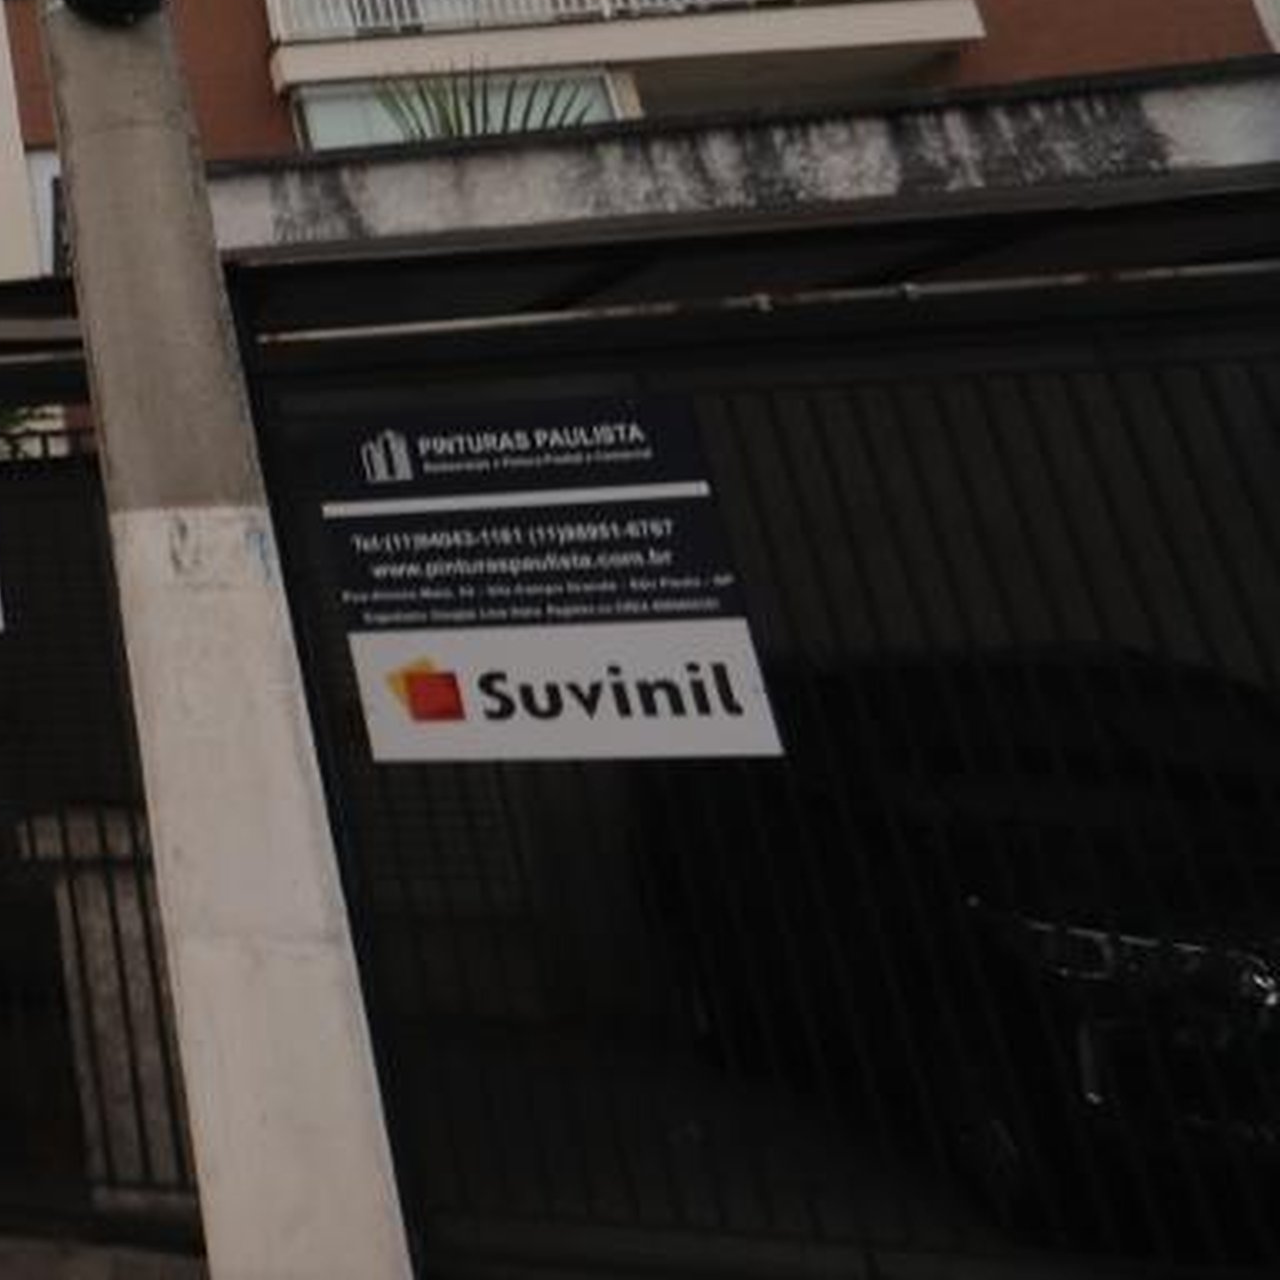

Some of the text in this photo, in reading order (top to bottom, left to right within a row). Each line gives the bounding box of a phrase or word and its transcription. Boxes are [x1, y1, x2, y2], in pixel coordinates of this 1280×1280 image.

[418, 422, 646, 456] PINTURAS PAULISTA
[477, 661, 744, 721] Suvinil
